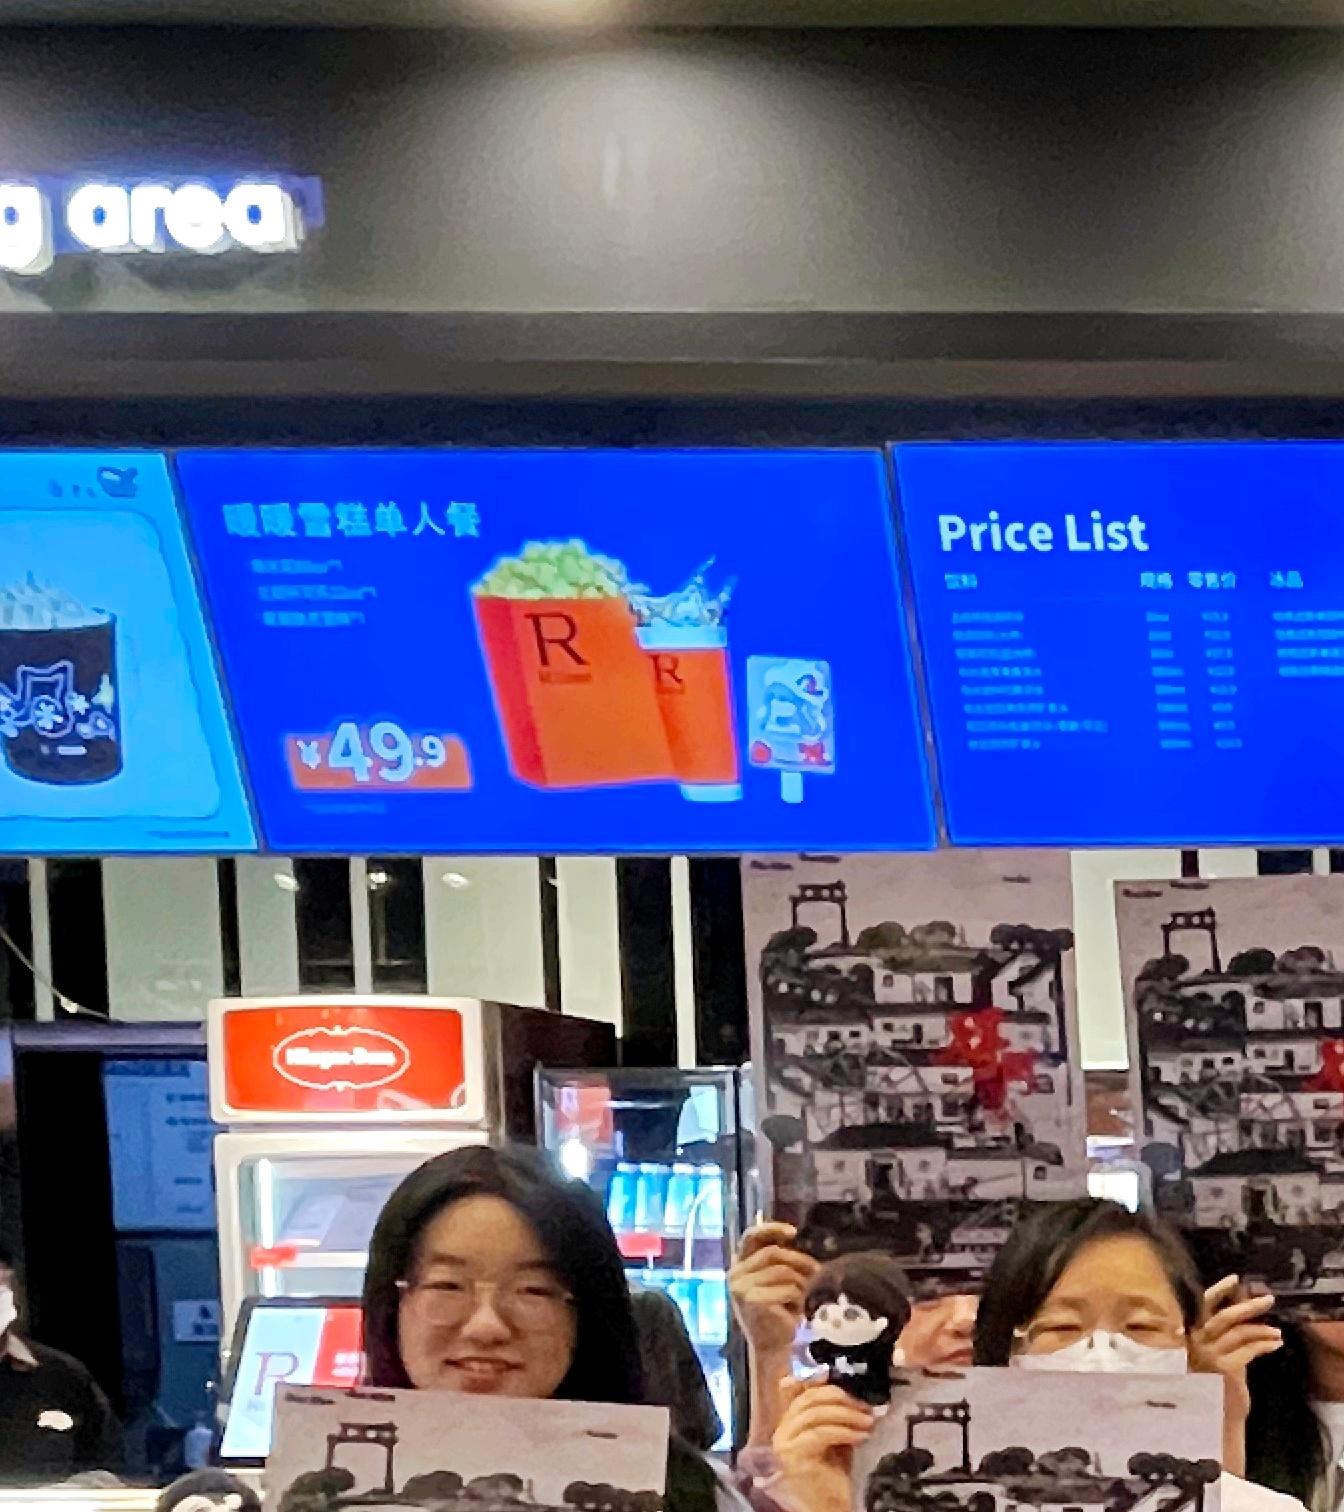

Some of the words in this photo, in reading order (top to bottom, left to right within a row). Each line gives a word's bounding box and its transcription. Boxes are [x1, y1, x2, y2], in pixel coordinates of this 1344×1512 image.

[67, 182, 302, 254] area
[938, 510, 1053, 551] Price
[1065, 510, 1150, 551] List
[524, 612, 590, 667] R
